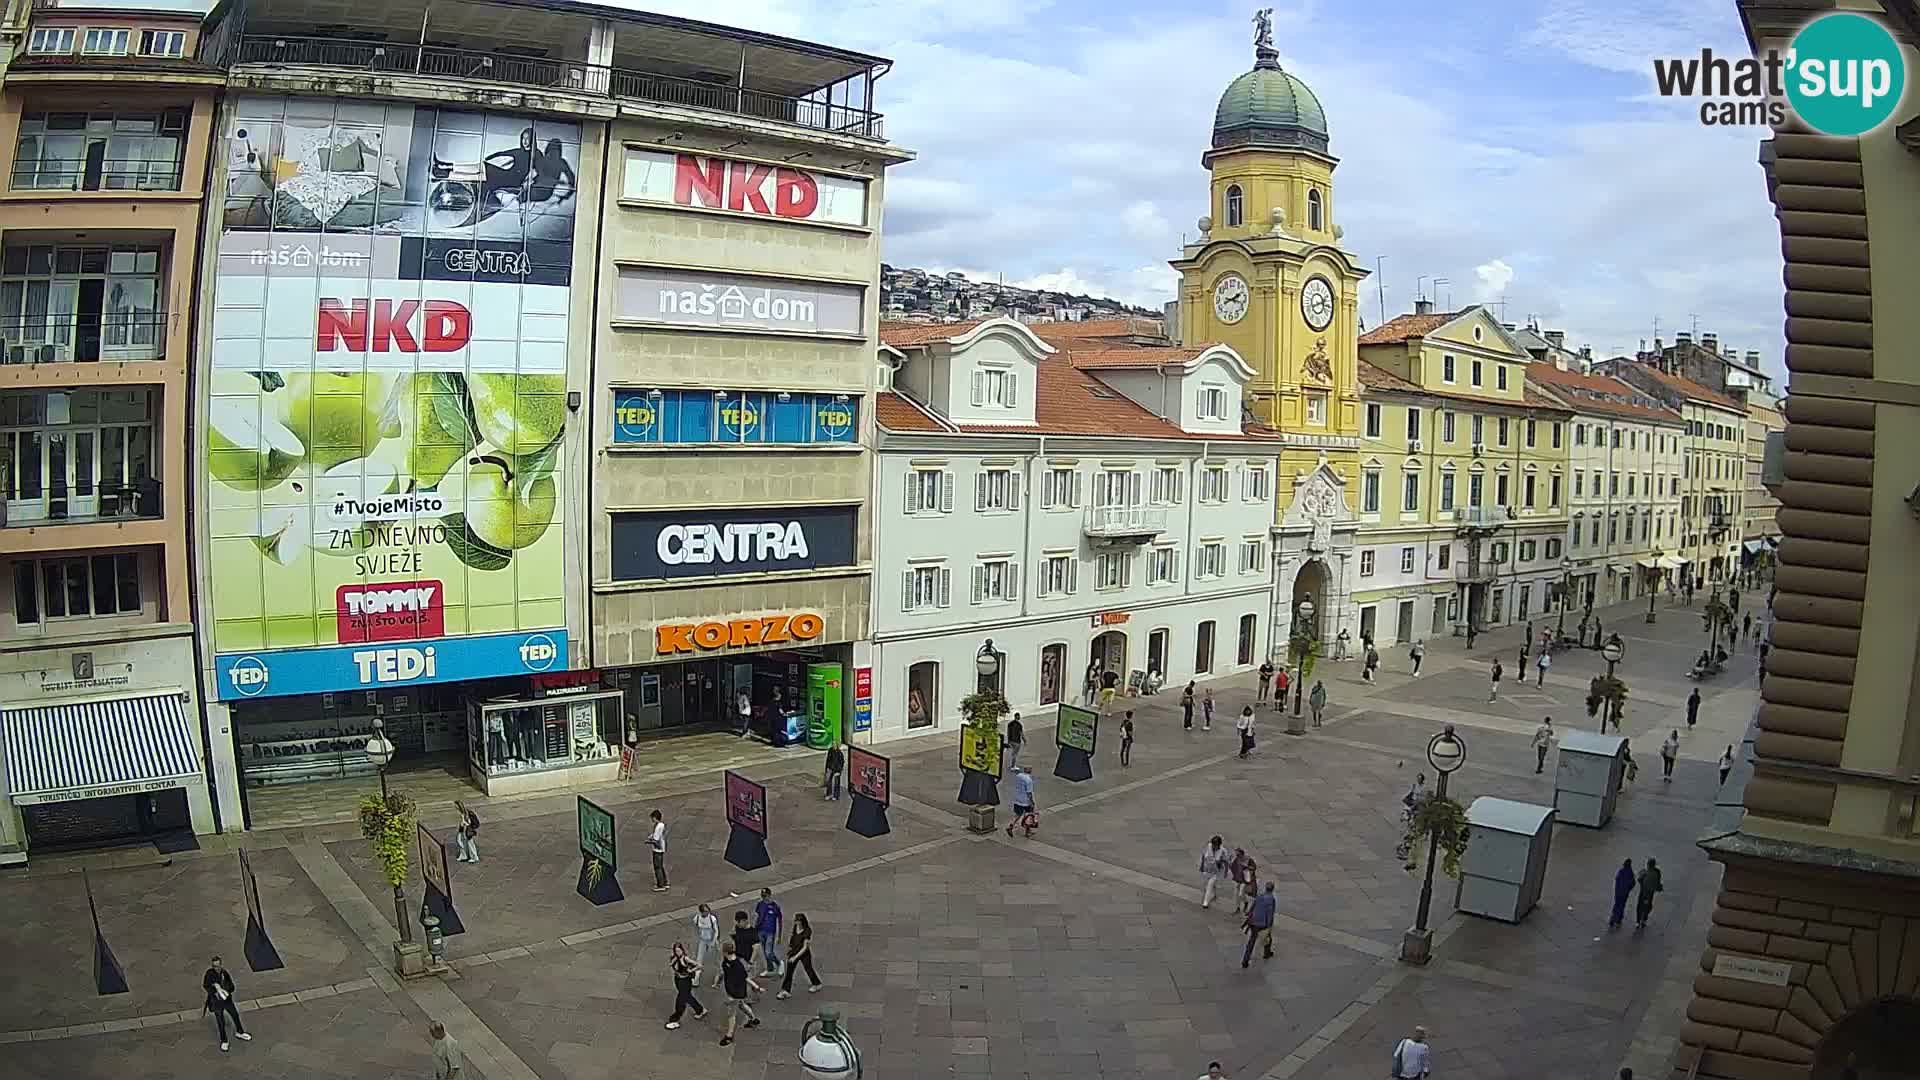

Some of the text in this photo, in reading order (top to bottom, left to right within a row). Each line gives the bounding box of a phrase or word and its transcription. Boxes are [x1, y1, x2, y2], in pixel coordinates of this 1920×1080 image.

[675, 153, 819, 218] NKD
[250, 244, 361, 267] naš dom
[445, 248, 532, 274] CENTRA
[659, 284, 815, 322] naš dom
[317, 297, 473, 353] NKD
[616, 408, 656, 424] TEDi
[720, 409, 758, 426] TEDi
[818, 410, 852, 427] TEDi
[333, 497, 443, 518] #TvojeMisto
[329, 523, 449, 550] ZA DNEVNO
[656, 521, 809, 565] CENTRA
[354, 548, 424, 577] SVJEŽE
[344, 587, 436, 616] TOMMY
[375, 614, 396, 627] ŠTO
[656, 613, 825, 656] KORZO
[519, 641, 557, 662] TEDi
[229, 666, 269, 685] TEDi
[353, 646, 437, 685] TEDi
[145, 780, 177, 791] CENTAR
